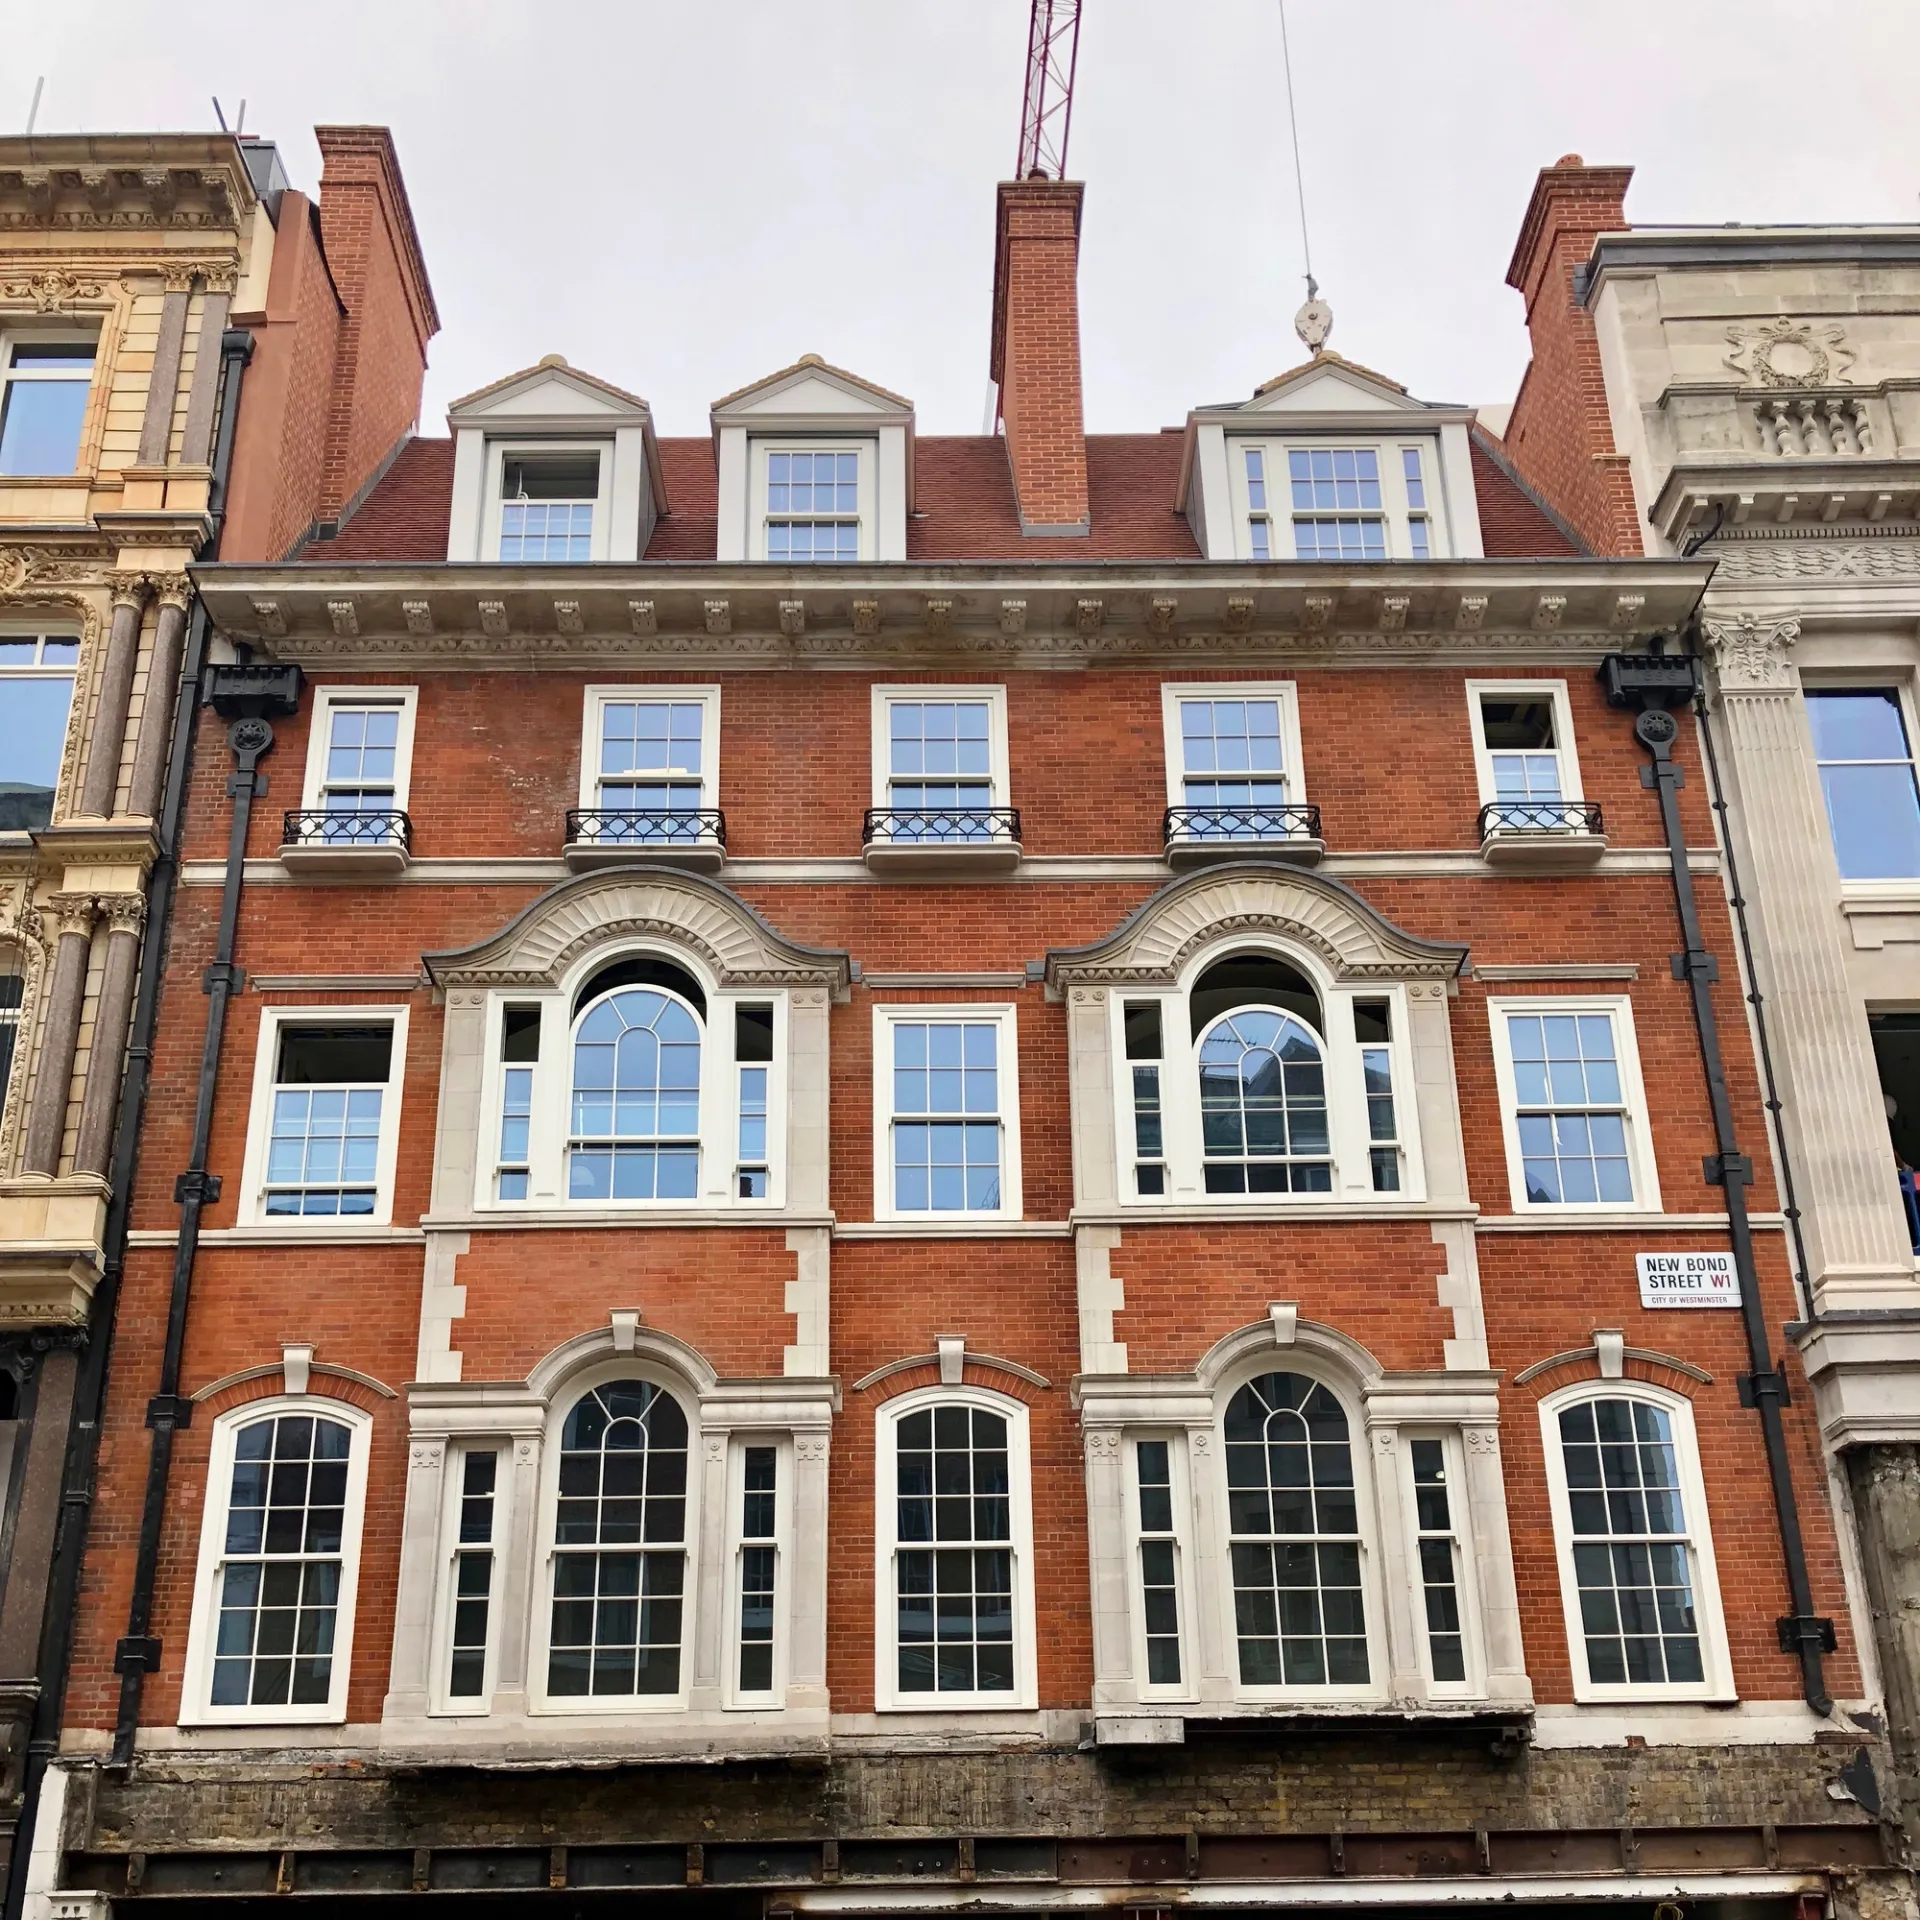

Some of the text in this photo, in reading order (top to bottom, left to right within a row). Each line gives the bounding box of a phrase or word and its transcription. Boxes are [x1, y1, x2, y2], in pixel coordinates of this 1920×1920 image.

[1646, 1258, 1727, 1272] NEW BOND
[1649, 1274, 1731, 1288] STREET W1
[1669, 1296, 1677, 1304] OF
[1679, 1296, 1728, 1304] WESTMINSTER
